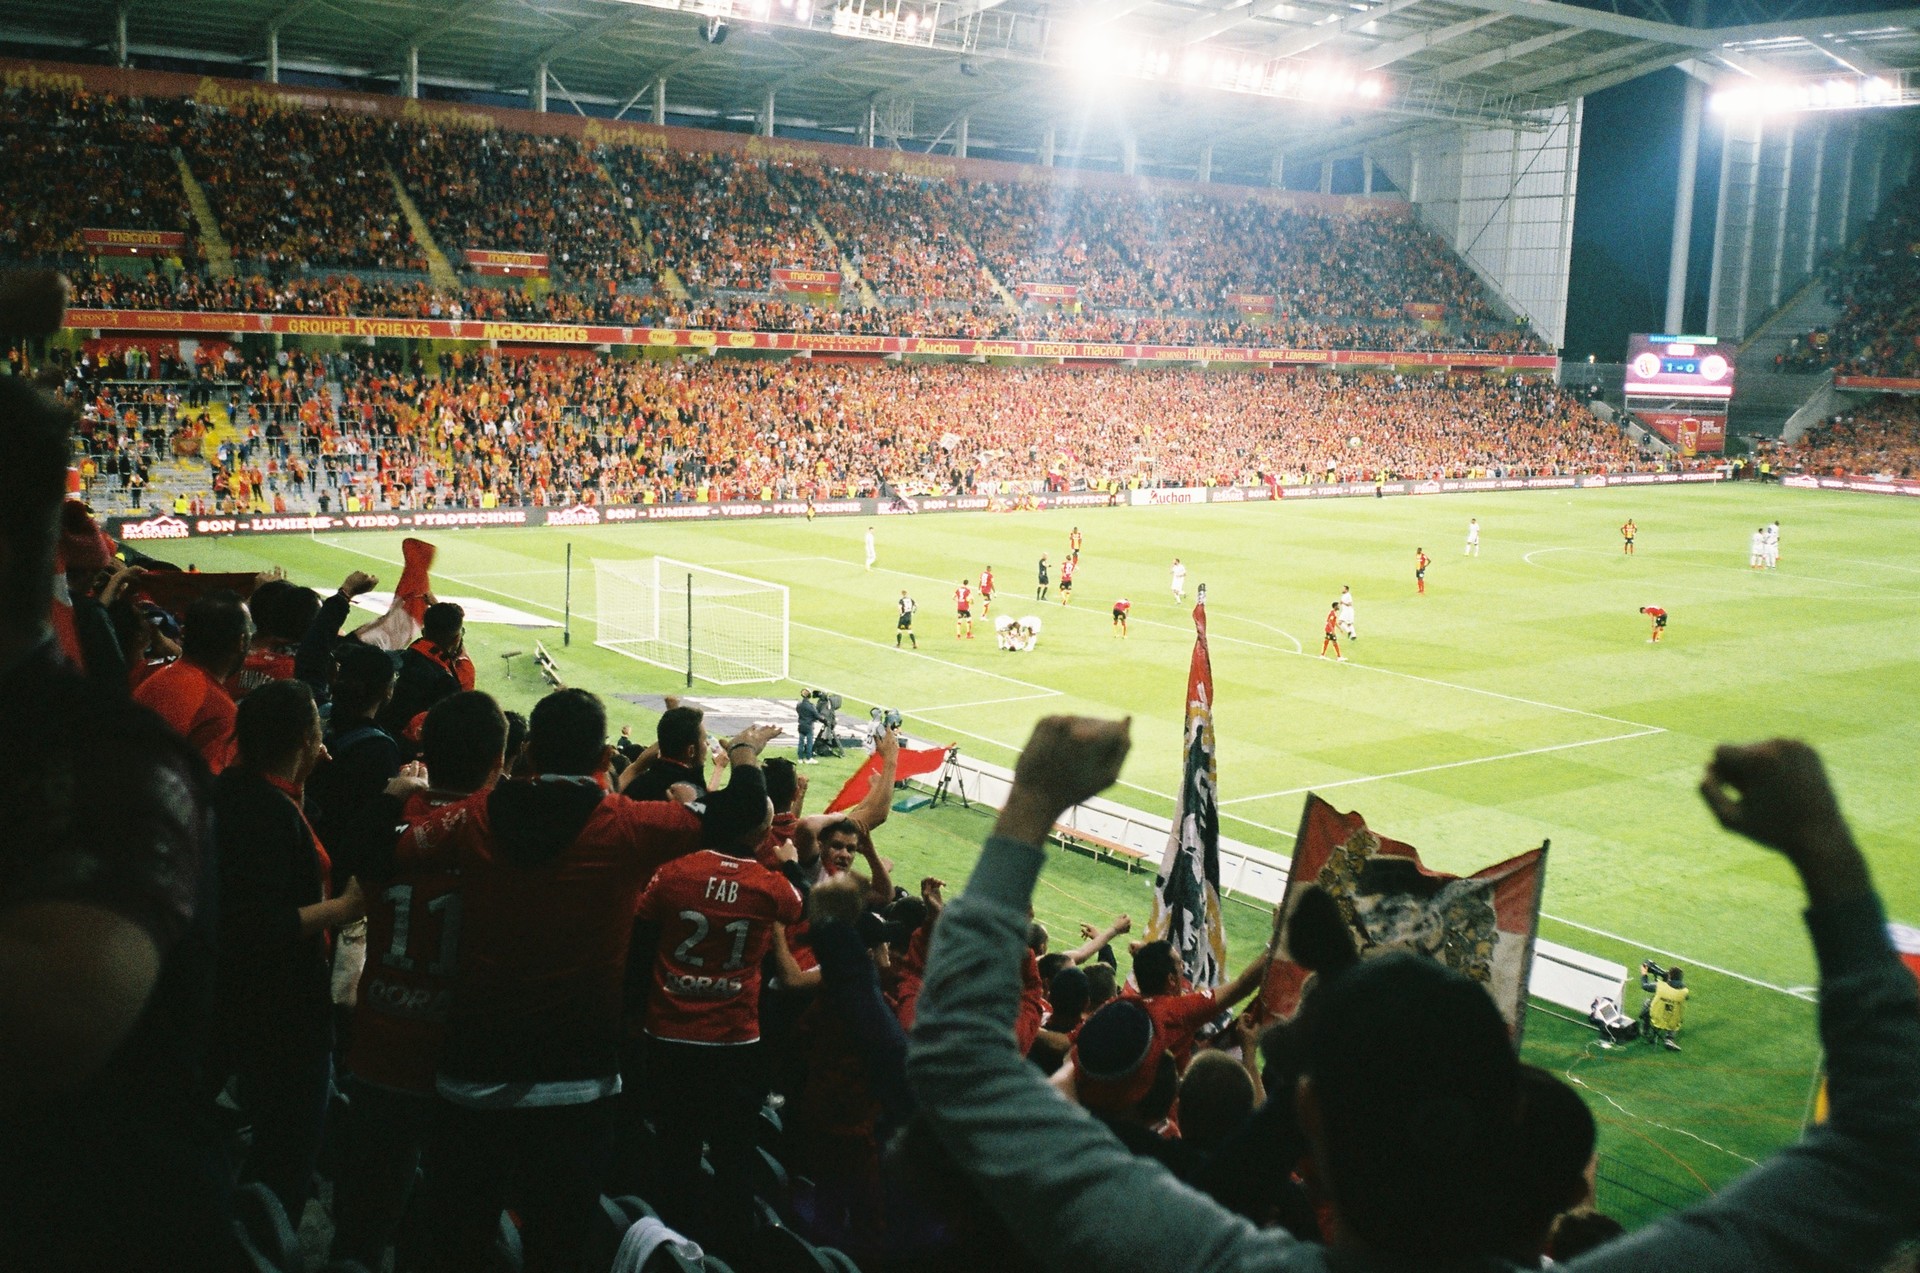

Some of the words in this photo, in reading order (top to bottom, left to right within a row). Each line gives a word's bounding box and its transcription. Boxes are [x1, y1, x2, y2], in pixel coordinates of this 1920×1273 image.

[2, 66, 84, 92] uchan
[790, 271, 825, 281] macron
[288, 319, 350, 335] GROUPE
[354, 319, 430, 337] KYRIELYS
[484, 323, 588, 342] McDonald's
[801, 335, 835, 344] FRANCE
[837, 337, 876, 345] CONFORT
[916, 339, 960, 354] Auchan
[973, 340, 1015, 355] Auchan
[1034, 344, 1076, 356] macron
[1083, 345, 1124, 357] macron
[1187, 347, 1223, 360] PHILIPPE
[1258, 351, 1283, 359] GROUPE
[1150, 489, 1191, 505] Auchan
[1317, 487, 1343, 495] VIDEO
[1351, 485, 1404, 493] PYROTCHNIE
[605, 508, 636, 520] SON
[722, 504, 763, 517] VIDEO
[774, 502, 861, 515] PYROECHNIE
[923, 499, 947, 510] SON
[197, 519, 236, 533] SON
[346, 513, 399, 528] VIDEO
[414, 511, 526, 526] PYROTECHNIE
[122, 532, 189, 540] PRODUCTION
[705, 876, 739, 904] FAB
[674, 910, 750, 970] 21
